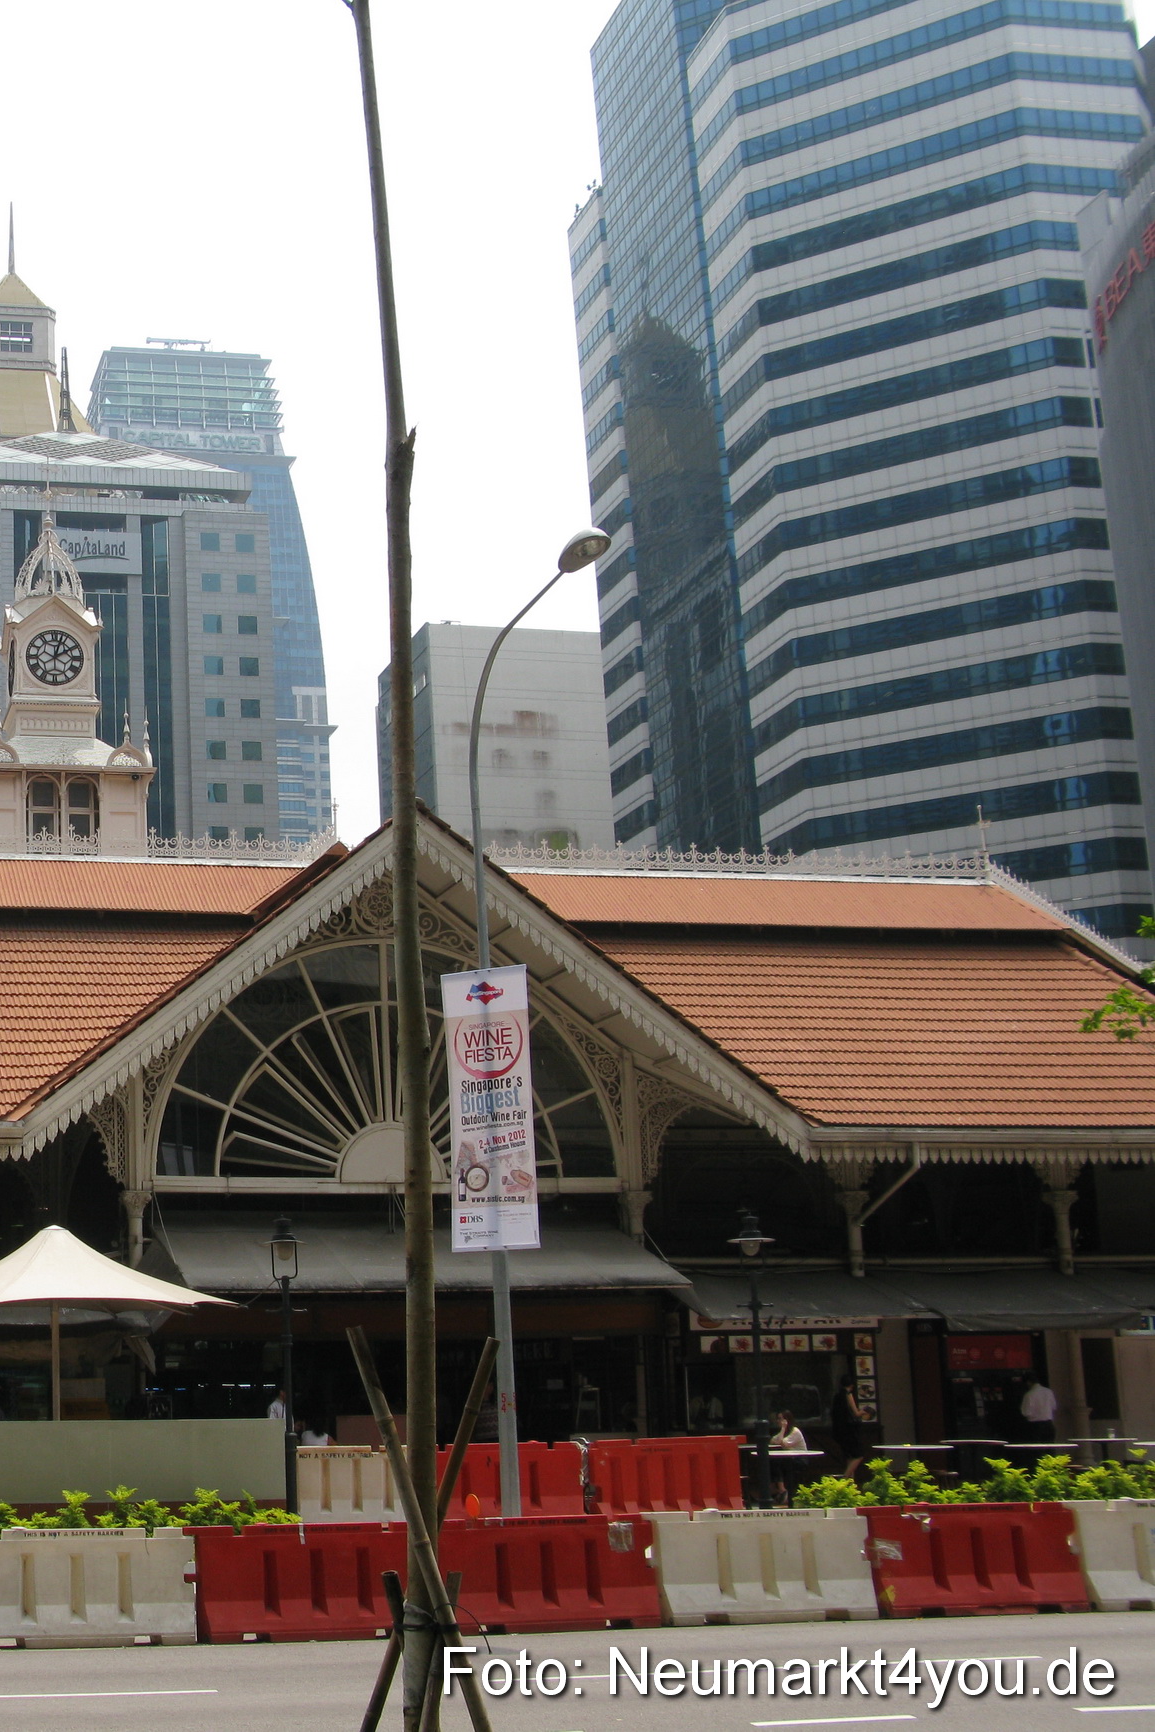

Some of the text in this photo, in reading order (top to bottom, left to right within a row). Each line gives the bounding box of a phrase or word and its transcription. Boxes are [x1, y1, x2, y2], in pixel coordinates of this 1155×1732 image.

[124, 430, 261, 450] CAPITAL TOWER
[59, 536, 126, 558] CapitaLand
[468, 1021, 505, 1031] SINGAPORE
[463, 1027, 513, 1048] WINE
[464, 1047, 514, 1064] FIESTA
[461, 1086, 520, 1115] Biggest
[461, 1109, 527, 1126] Outdoor Wine Fair
[479, 1129, 526, 1149] 2-4 Nov 2012
[467, 1215, 484, 1223] DBS
